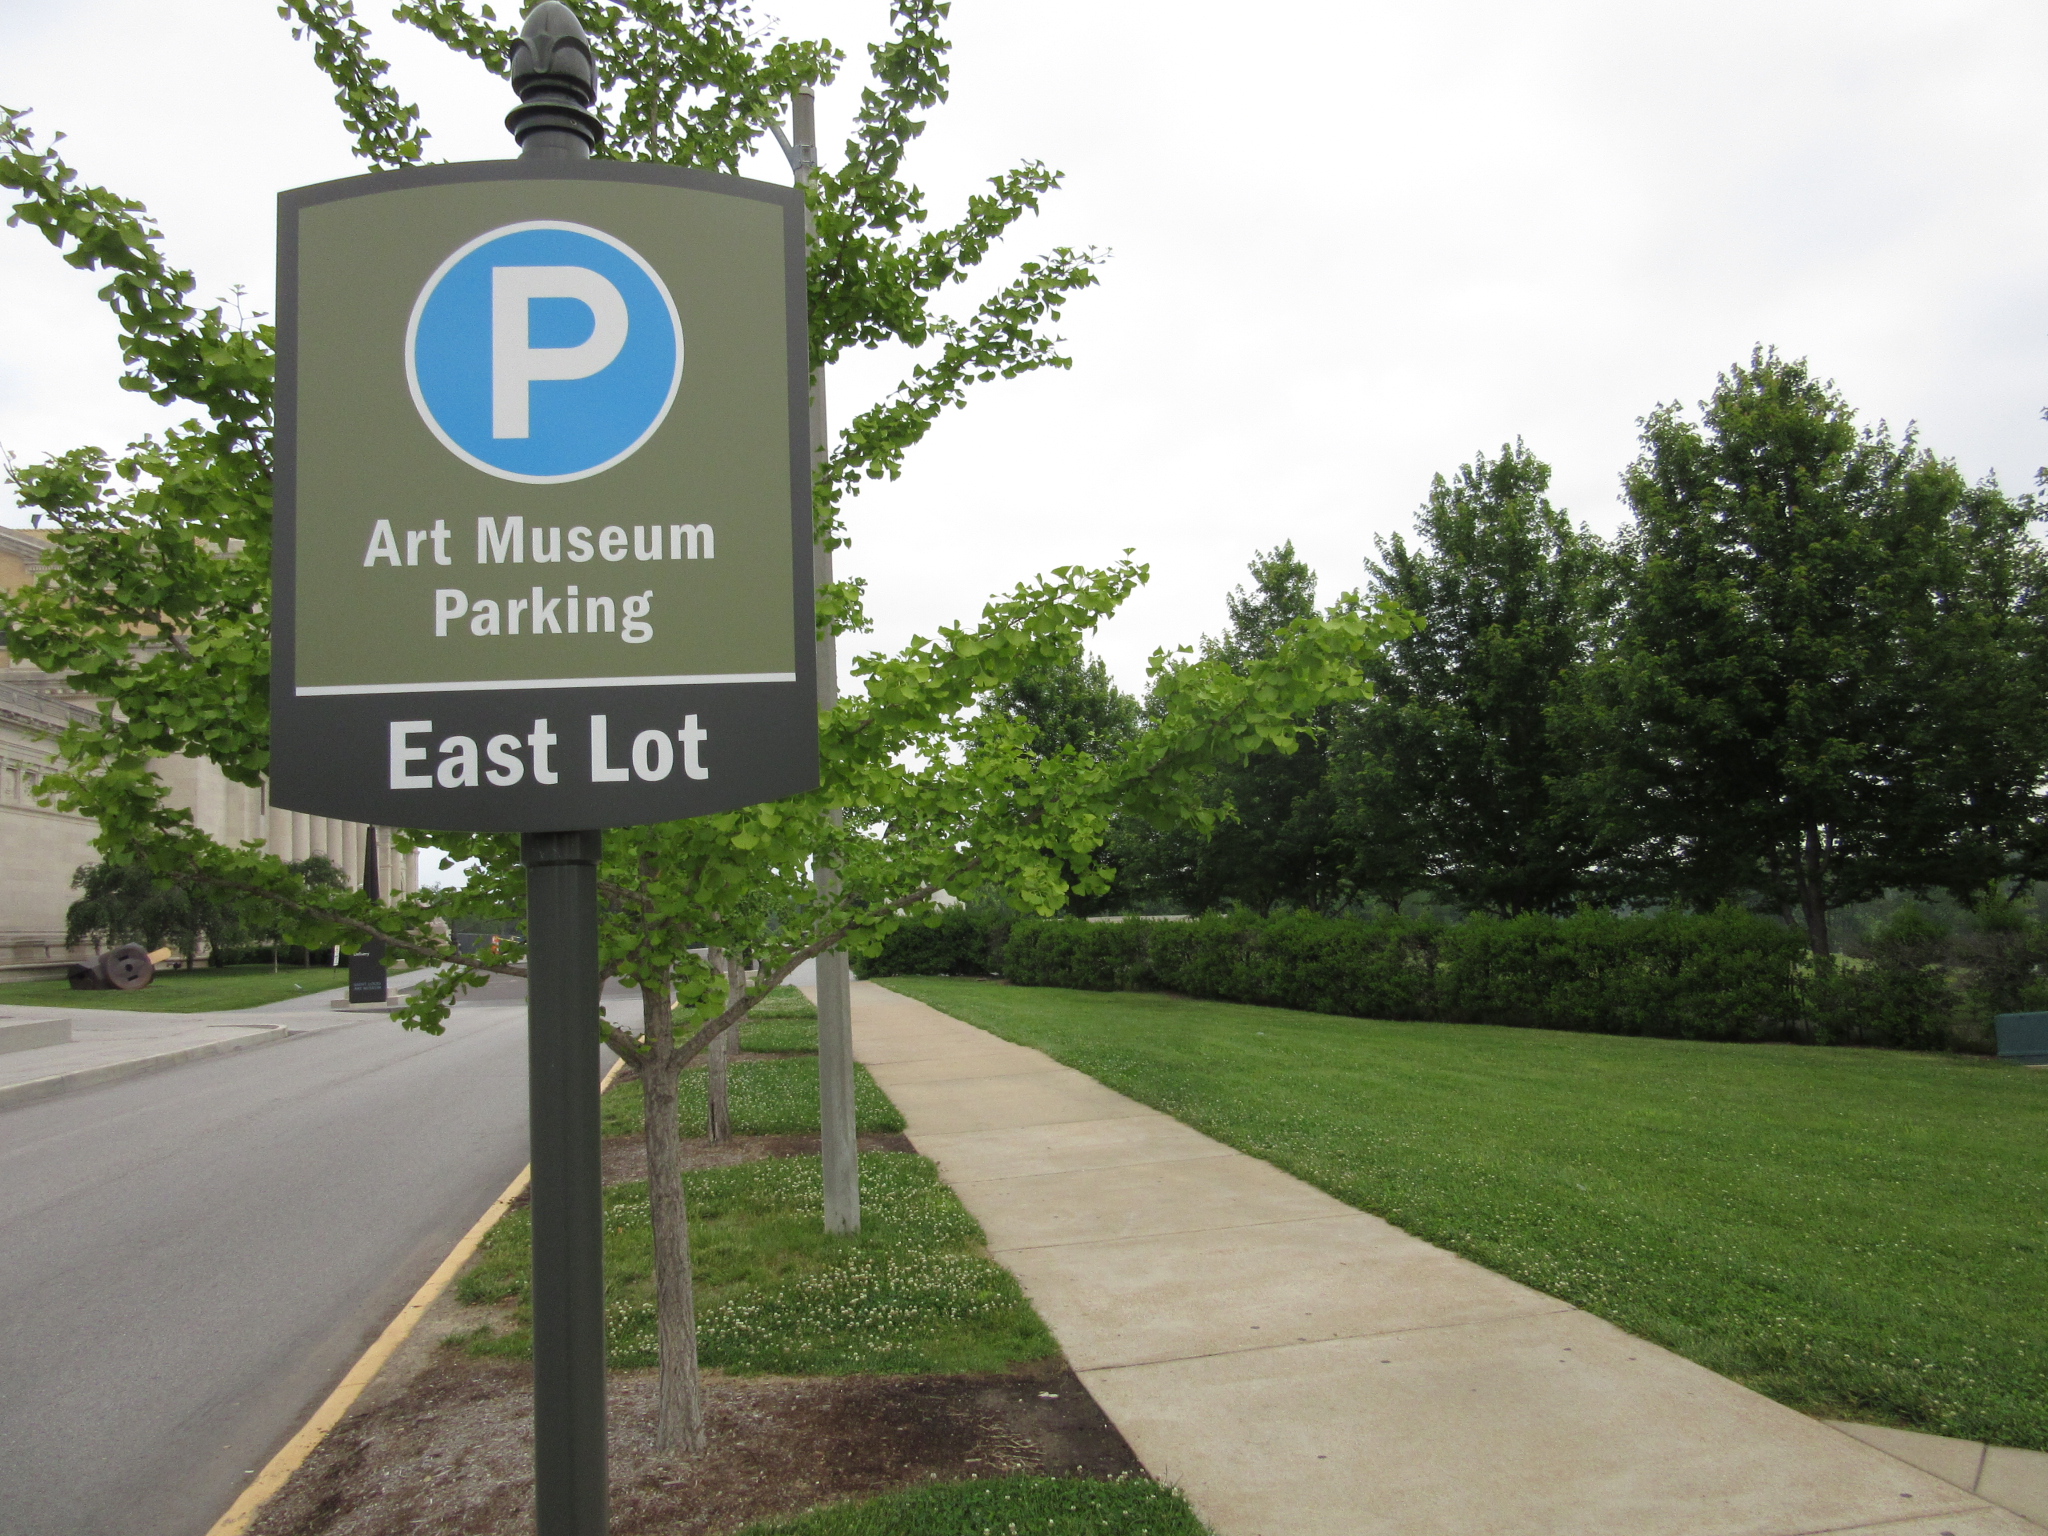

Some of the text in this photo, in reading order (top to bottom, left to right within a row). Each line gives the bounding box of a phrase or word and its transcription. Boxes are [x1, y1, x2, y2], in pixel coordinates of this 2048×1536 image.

[492, 265, 629, 439] P
[363, 516, 715, 567] Art Museum
[434, 586, 655, 645] Parking
[389, 713, 710, 790] East Lot
